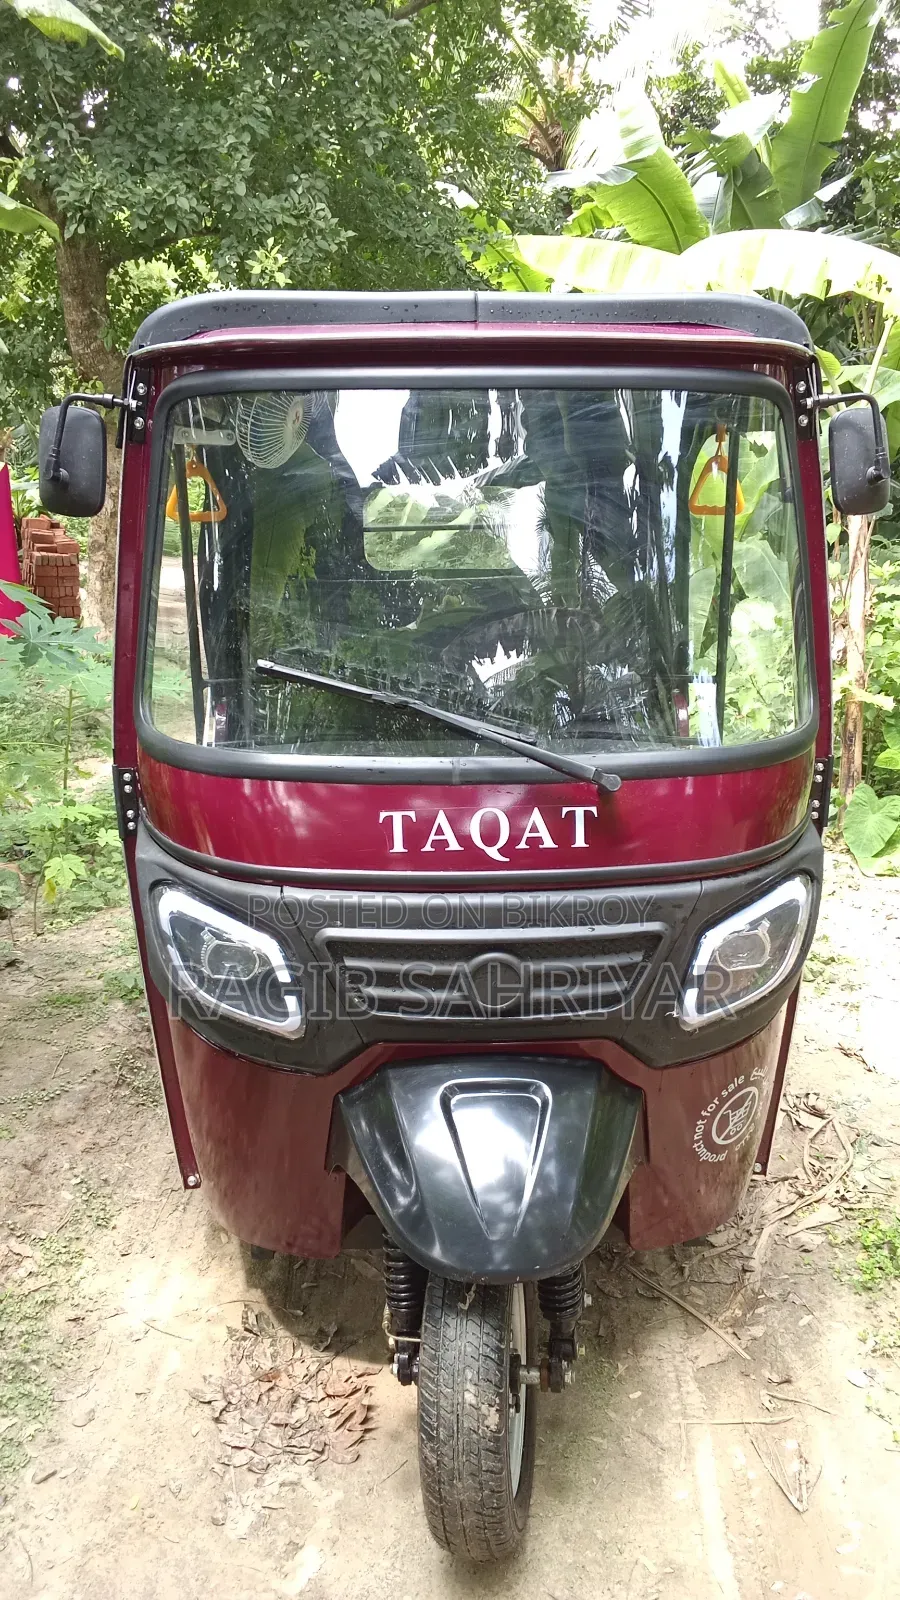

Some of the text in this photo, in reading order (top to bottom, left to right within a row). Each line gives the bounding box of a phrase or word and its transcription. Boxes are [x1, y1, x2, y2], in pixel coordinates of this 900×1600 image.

[379, 806, 598, 862] TAQAT
[692, 1075, 745, 1163] product not for sale
